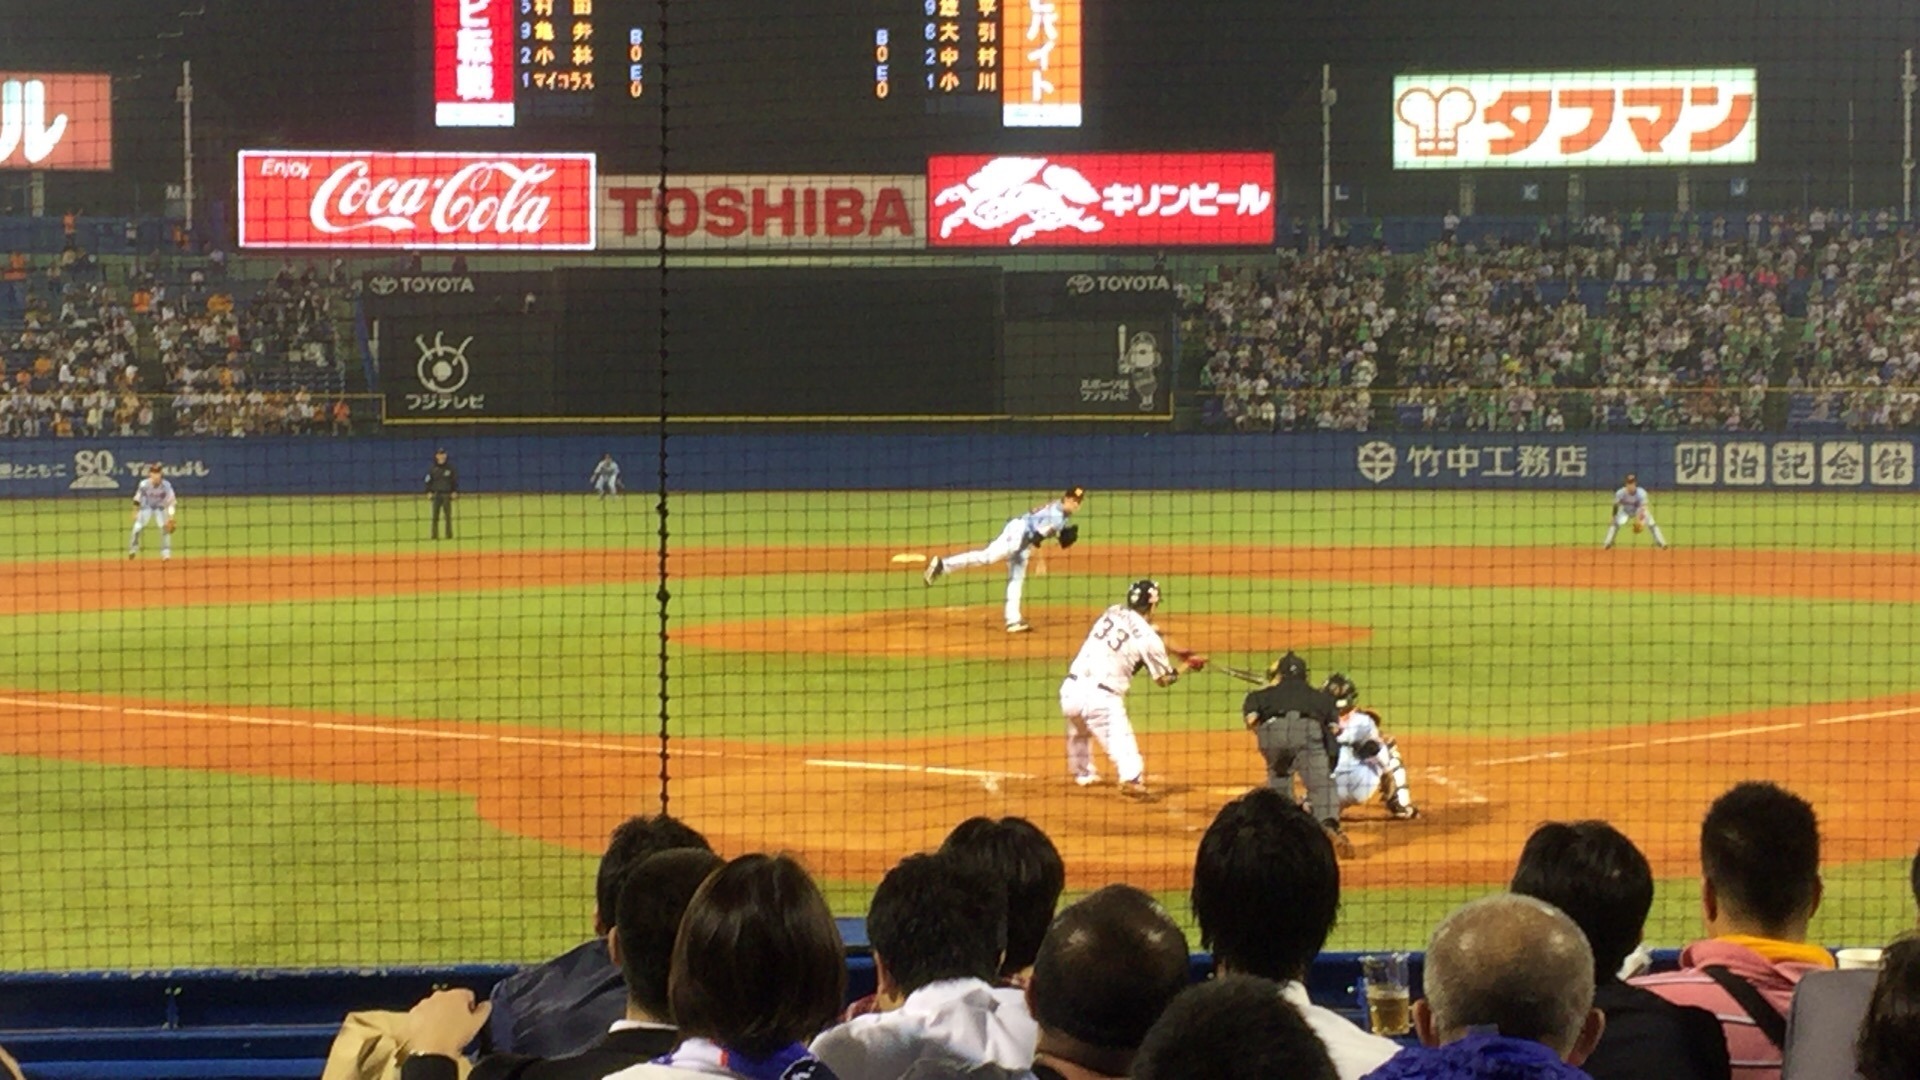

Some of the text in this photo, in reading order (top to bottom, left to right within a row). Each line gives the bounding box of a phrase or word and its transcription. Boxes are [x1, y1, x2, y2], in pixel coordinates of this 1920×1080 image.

[925, 22, 936, 40] 6
[521, 46, 531, 64] 2
[925, 47, 936, 65] 2
[522, 70, 595, 91] 1 マイコラス
[926, 72, 935, 90] 1
[1483, 86, 1754, 156] タフマン
[261, 158, 312, 180] Enjoy
[309, 159, 556, 235] Coca-Cola
[1102, 183, 1272, 216] キリンビール
[608, 187, 915, 238] TOSHIBA
[400, 276, 475, 293] TOYOTA
[1097, 275, 1170, 292] TOYOTA
[405, 393, 485, 411] フジテレビ
[1406, 445, 1588, 478] 竹中工務店
[1678, 443, 1912, 484] 明治記念館
[1093, 616, 1130, 652] 33
